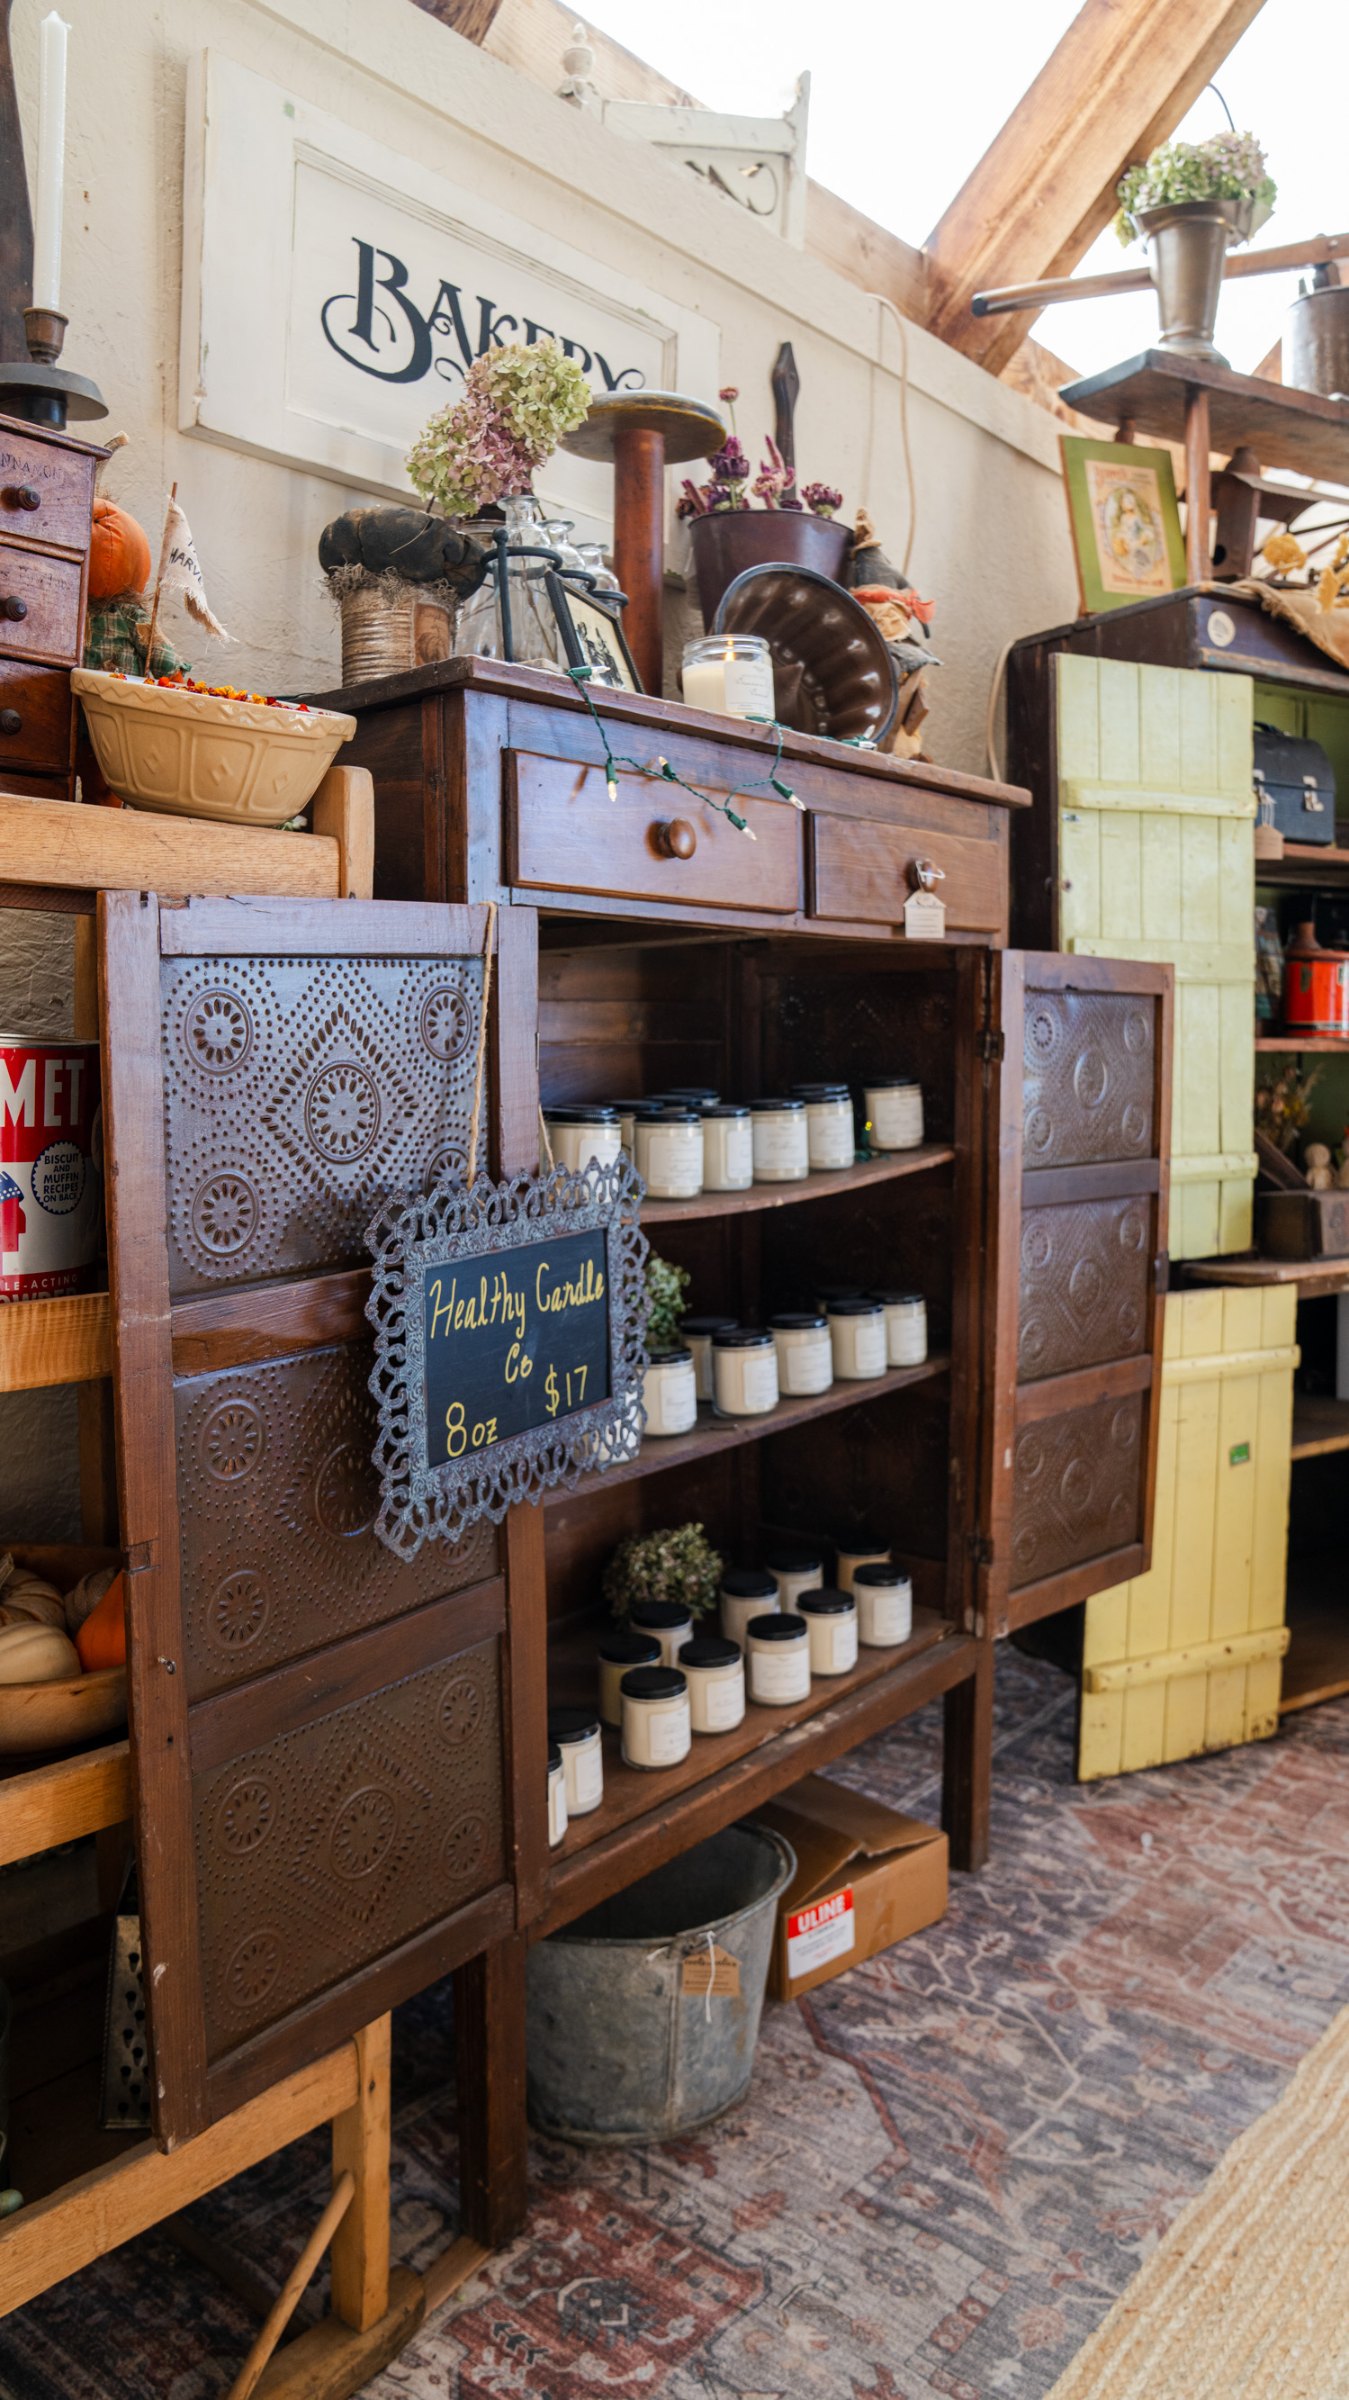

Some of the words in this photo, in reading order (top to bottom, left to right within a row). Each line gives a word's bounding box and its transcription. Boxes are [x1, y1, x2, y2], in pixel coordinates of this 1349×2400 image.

[44, 1153, 79, 1165] BISCUIT
[53, 1164, 71, 1173] AND
[43, 1172, 79, 1184] MUFFIN
[43, 1182, 79, 1194] RECIPES
[43, 1194, 57, 1203] ON
[429, 1271, 526, 1339] Healthy
[536, 1259, 605, 1312] Candle
[505, 1342, 533, 1384] Co
[544, 1363, 588, 1417] $17
[797, 1894, 845, 1933] ULINE
